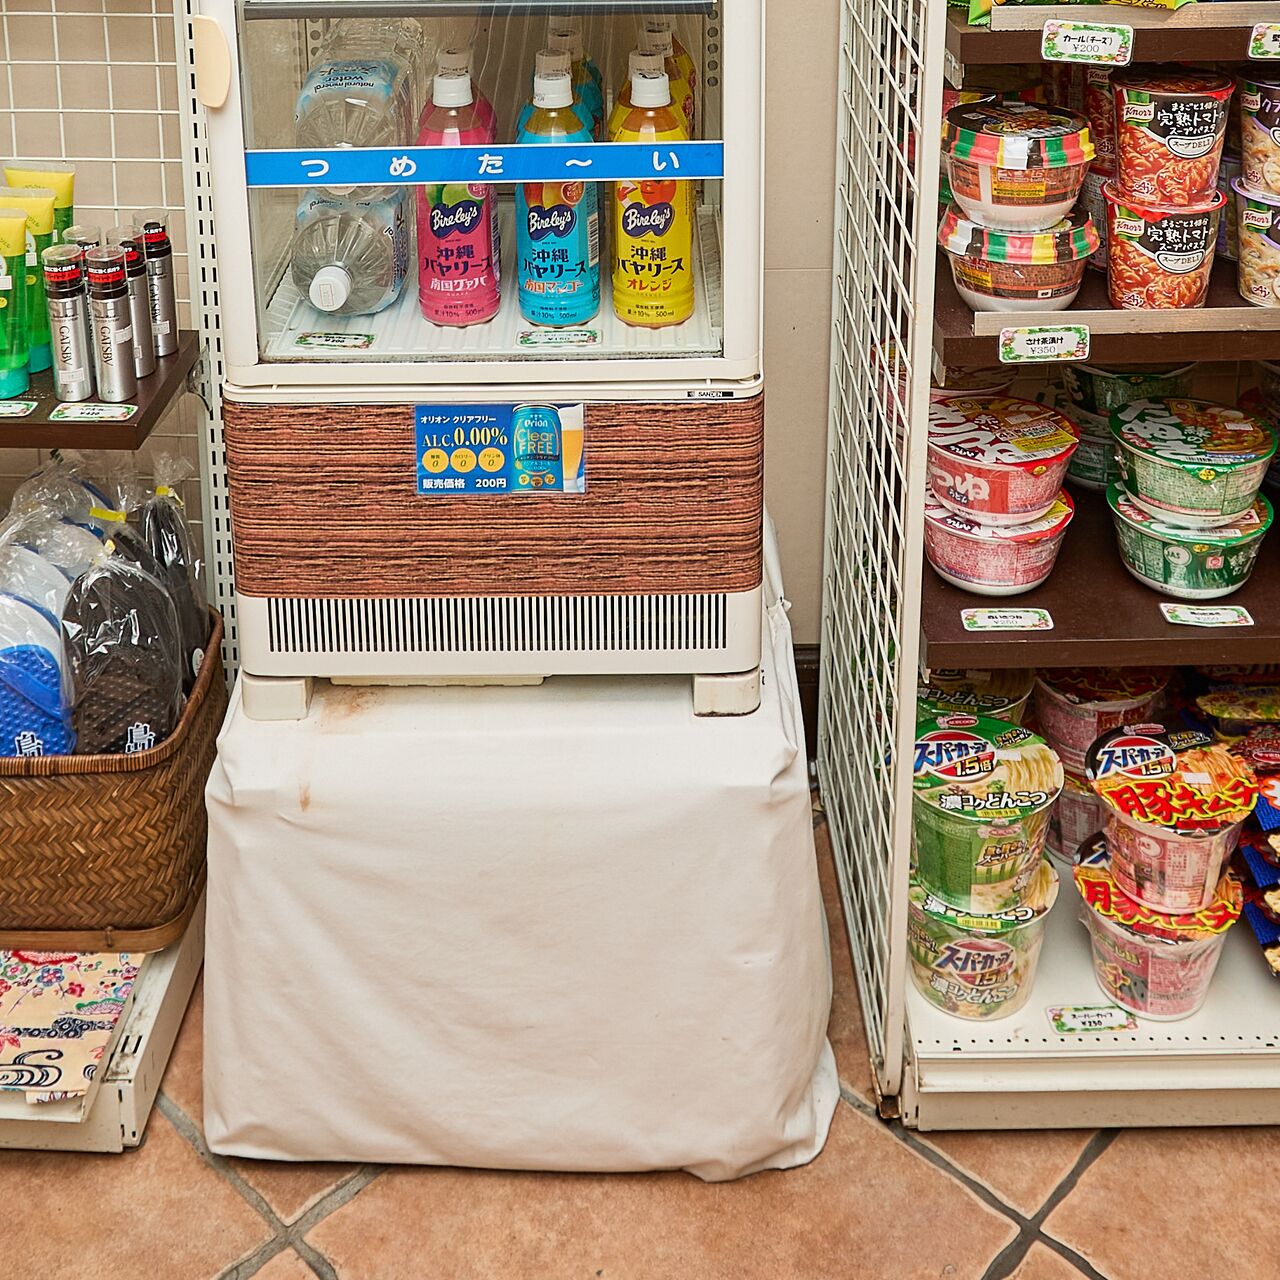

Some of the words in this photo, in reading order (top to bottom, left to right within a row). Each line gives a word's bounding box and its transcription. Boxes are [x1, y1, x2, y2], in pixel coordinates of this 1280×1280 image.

[1063, 34, 1113, 46] カール(チーズ)
[1125, 106, 1152, 116] Knorr
[1170, 124, 1215, 134] スープパスタ
[431, 206, 480, 231] Bireley's
[528, 208, 572, 232] Bireley's
[625, 207, 672, 231] Bireley's
[1159, 240, 1206, 251] スープパスタ
[436, 246, 475, 261] 沖縄
[532, 247, 569, 262] 沖縄
[630, 246, 667, 261] 沖縄
[424, 261, 493, 279] バヤリース
[626, 279, 673, 292] オレンジ
[60, 325, 72, 366] GATSBY
[100, 326, 112, 366] GATSBY
[1030, 346, 1056, 355] ¥350
[520, 443, 552, 454] FREE
[423, 479, 465, 489] 販売価格
[476, 478, 506, 488] 200円
[940, 791, 1048, 810] 濃コクとんこつ
[1070, 1011, 1113, 1020] スーパーカップ
